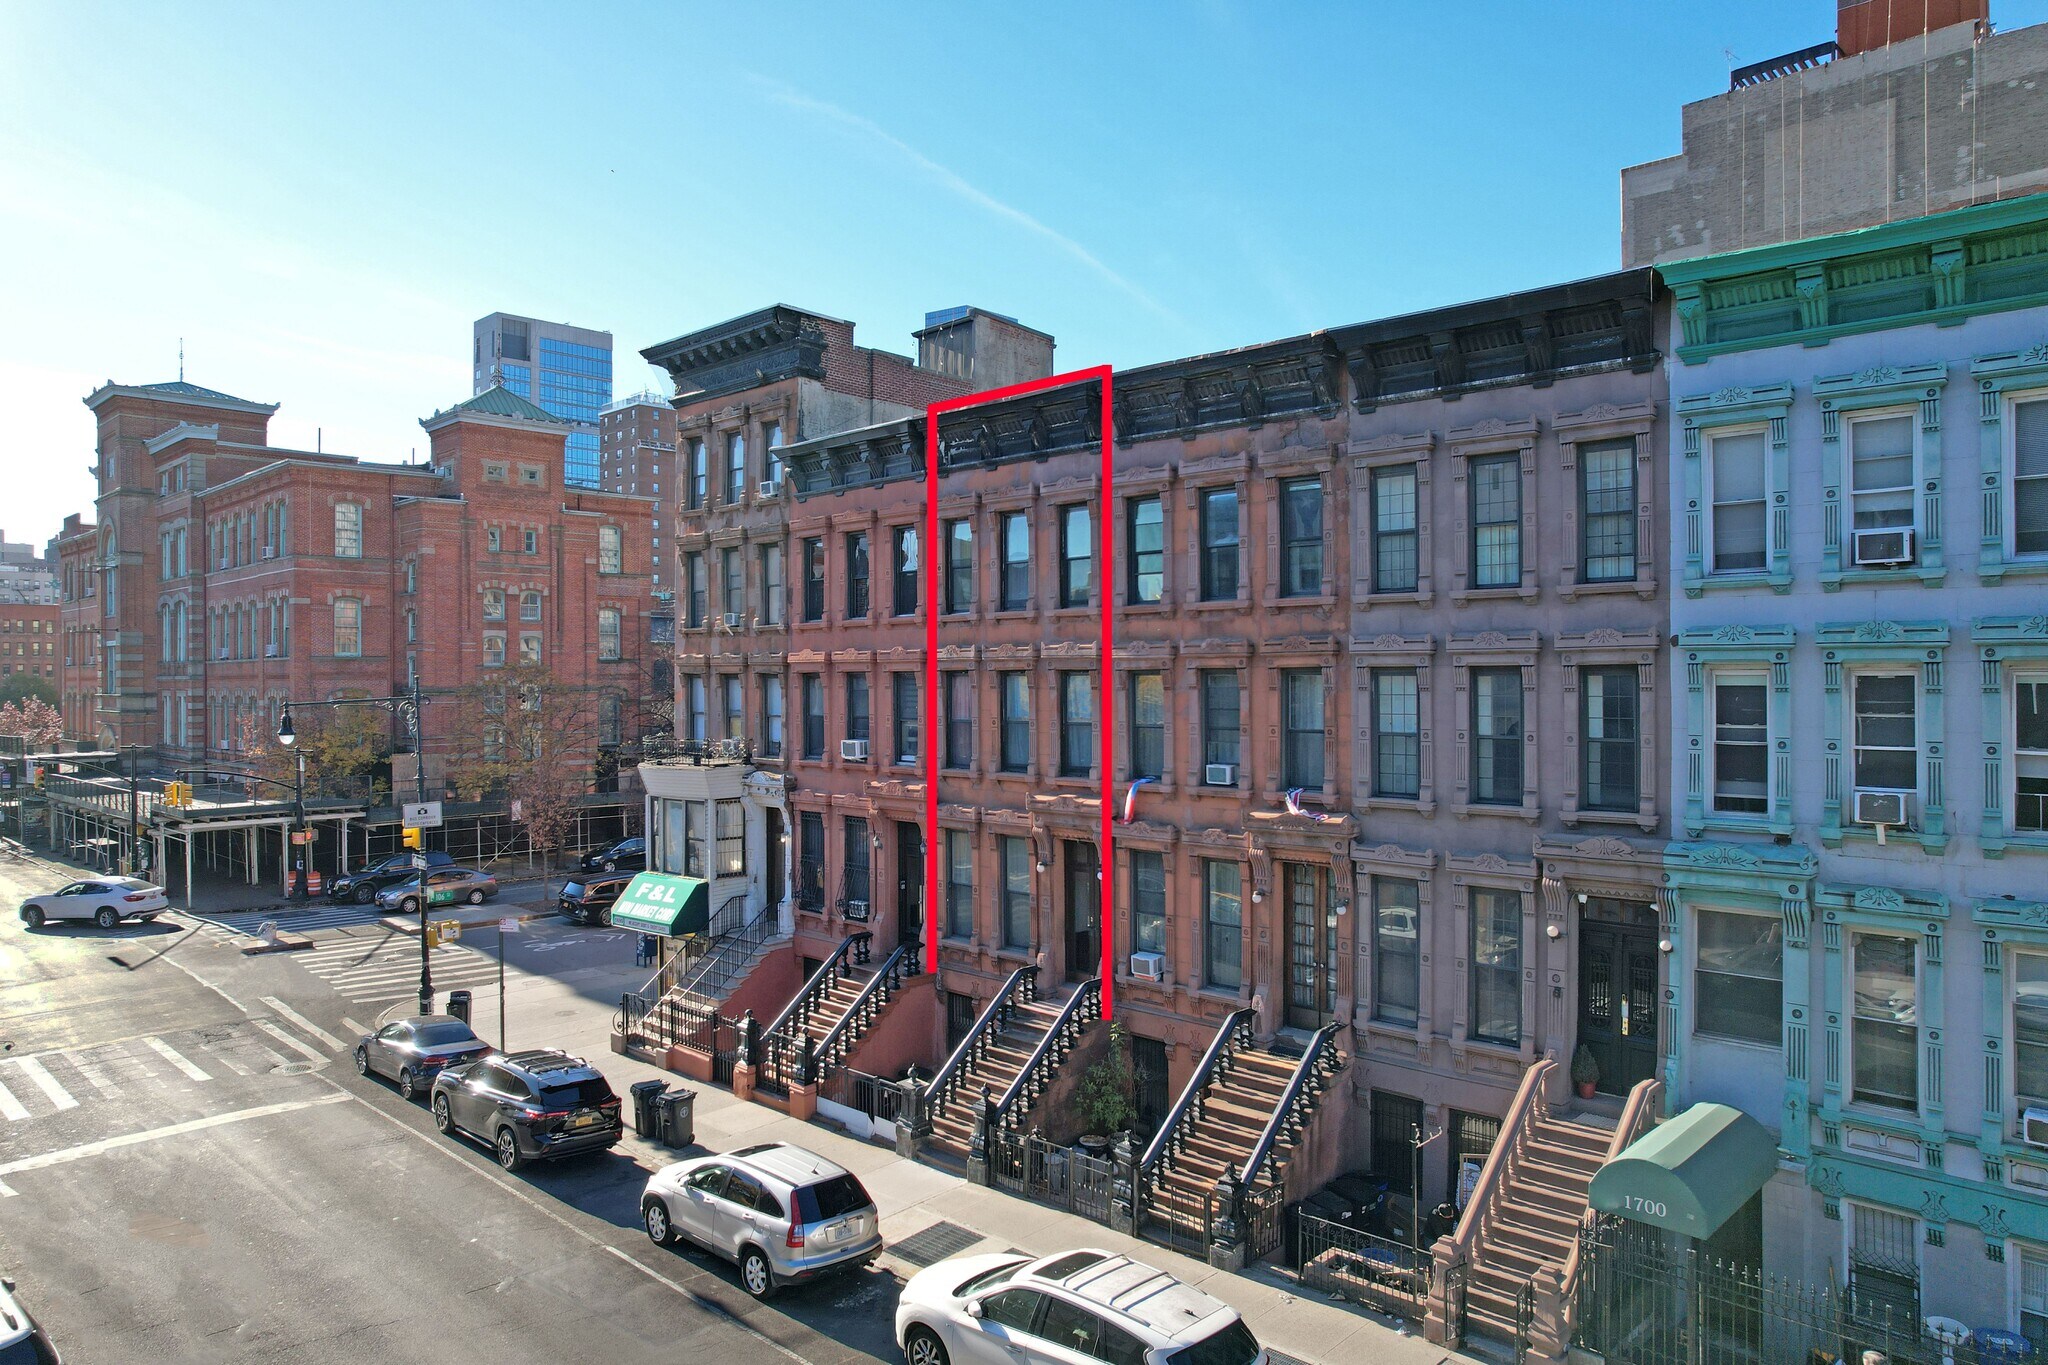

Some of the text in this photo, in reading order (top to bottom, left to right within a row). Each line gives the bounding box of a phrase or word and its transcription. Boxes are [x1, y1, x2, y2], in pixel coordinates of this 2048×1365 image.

[435, 893, 445, 901] 106
[635, 882, 675, 902] F&L
[617, 901, 635, 914] MINI
[630, 903, 659, 918] MARKET
[1624, 1195, 1667, 1217] 1700
